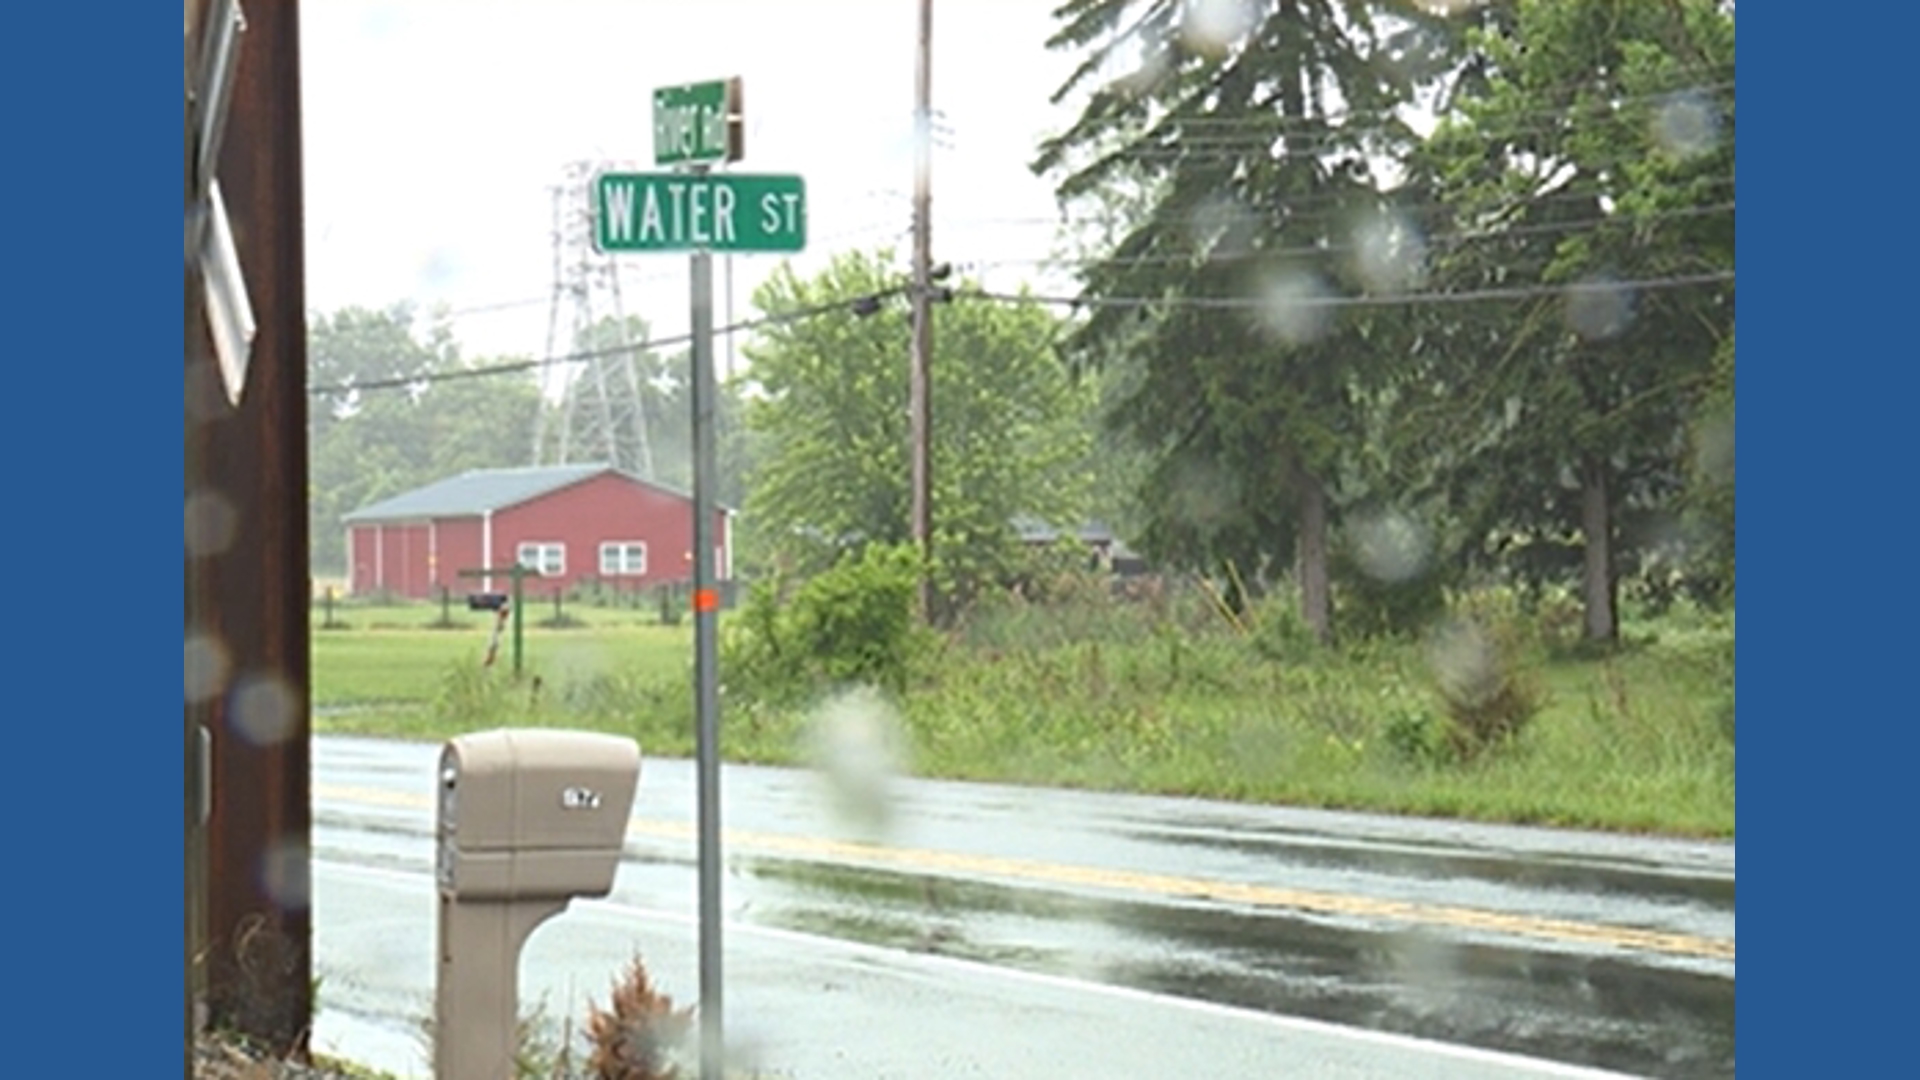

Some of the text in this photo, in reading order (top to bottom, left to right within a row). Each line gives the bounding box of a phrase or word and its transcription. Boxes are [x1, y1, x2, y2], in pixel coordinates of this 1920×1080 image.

[654, 100, 698, 156] River
[603, 182, 801, 243] WATER ST
